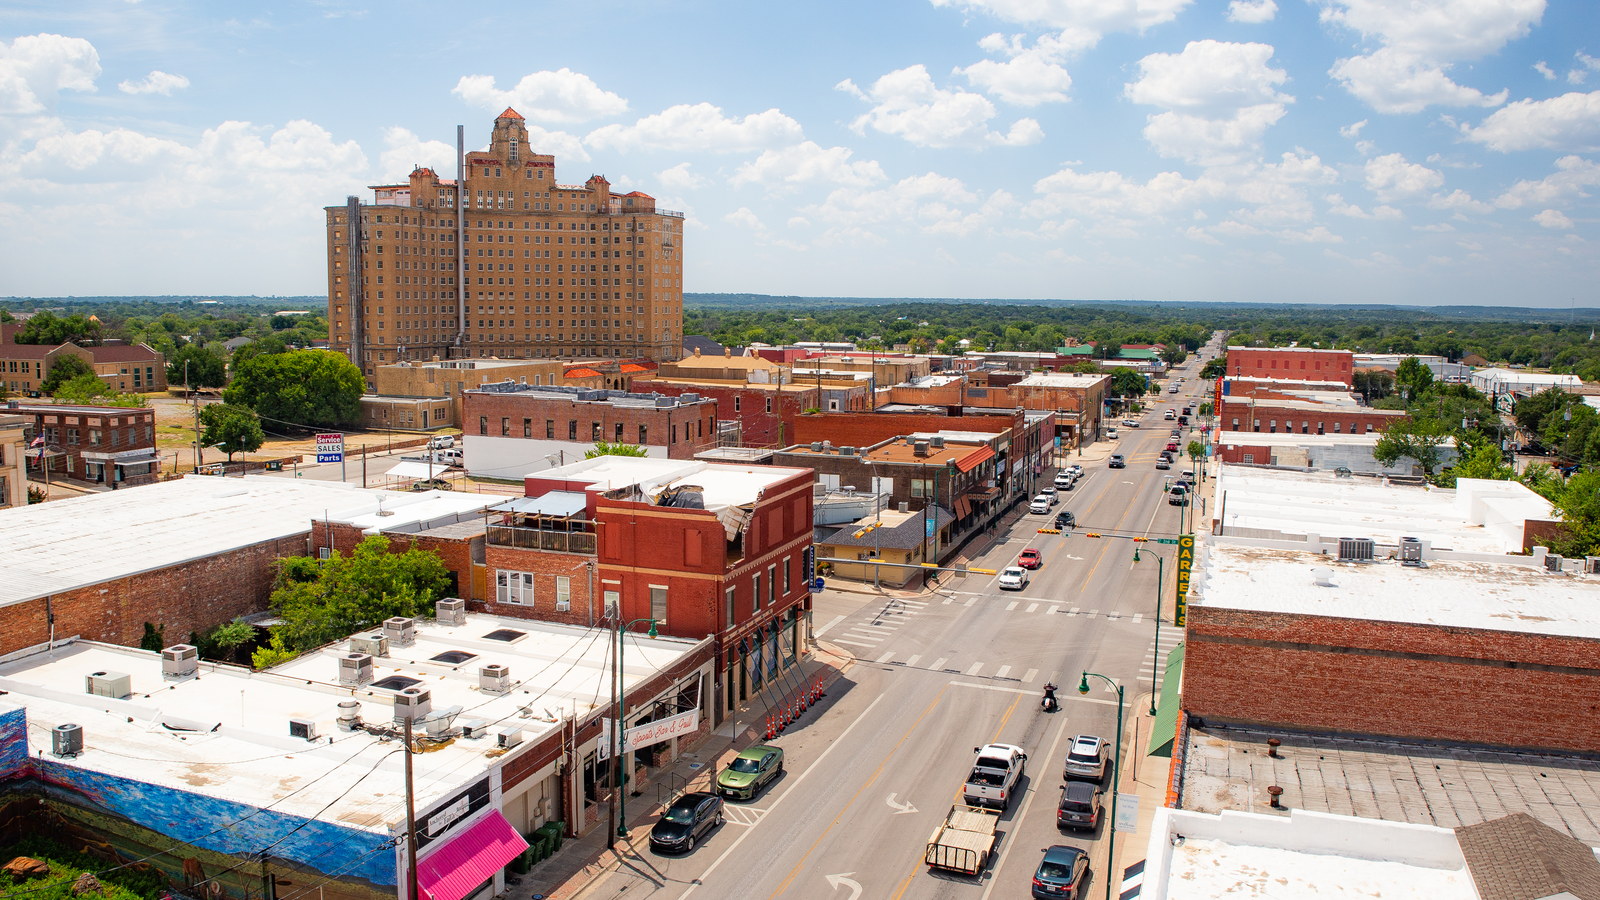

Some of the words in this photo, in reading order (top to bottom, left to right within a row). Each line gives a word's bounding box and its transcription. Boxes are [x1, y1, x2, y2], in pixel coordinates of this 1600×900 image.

[1178, 538, 1193, 625] GARRETTS
[631, 729, 654, 747] Sports
[655, 725, 668, 738] Bar
[669, 721, 676, 733] &
[677, 715, 694, 732] Grill
